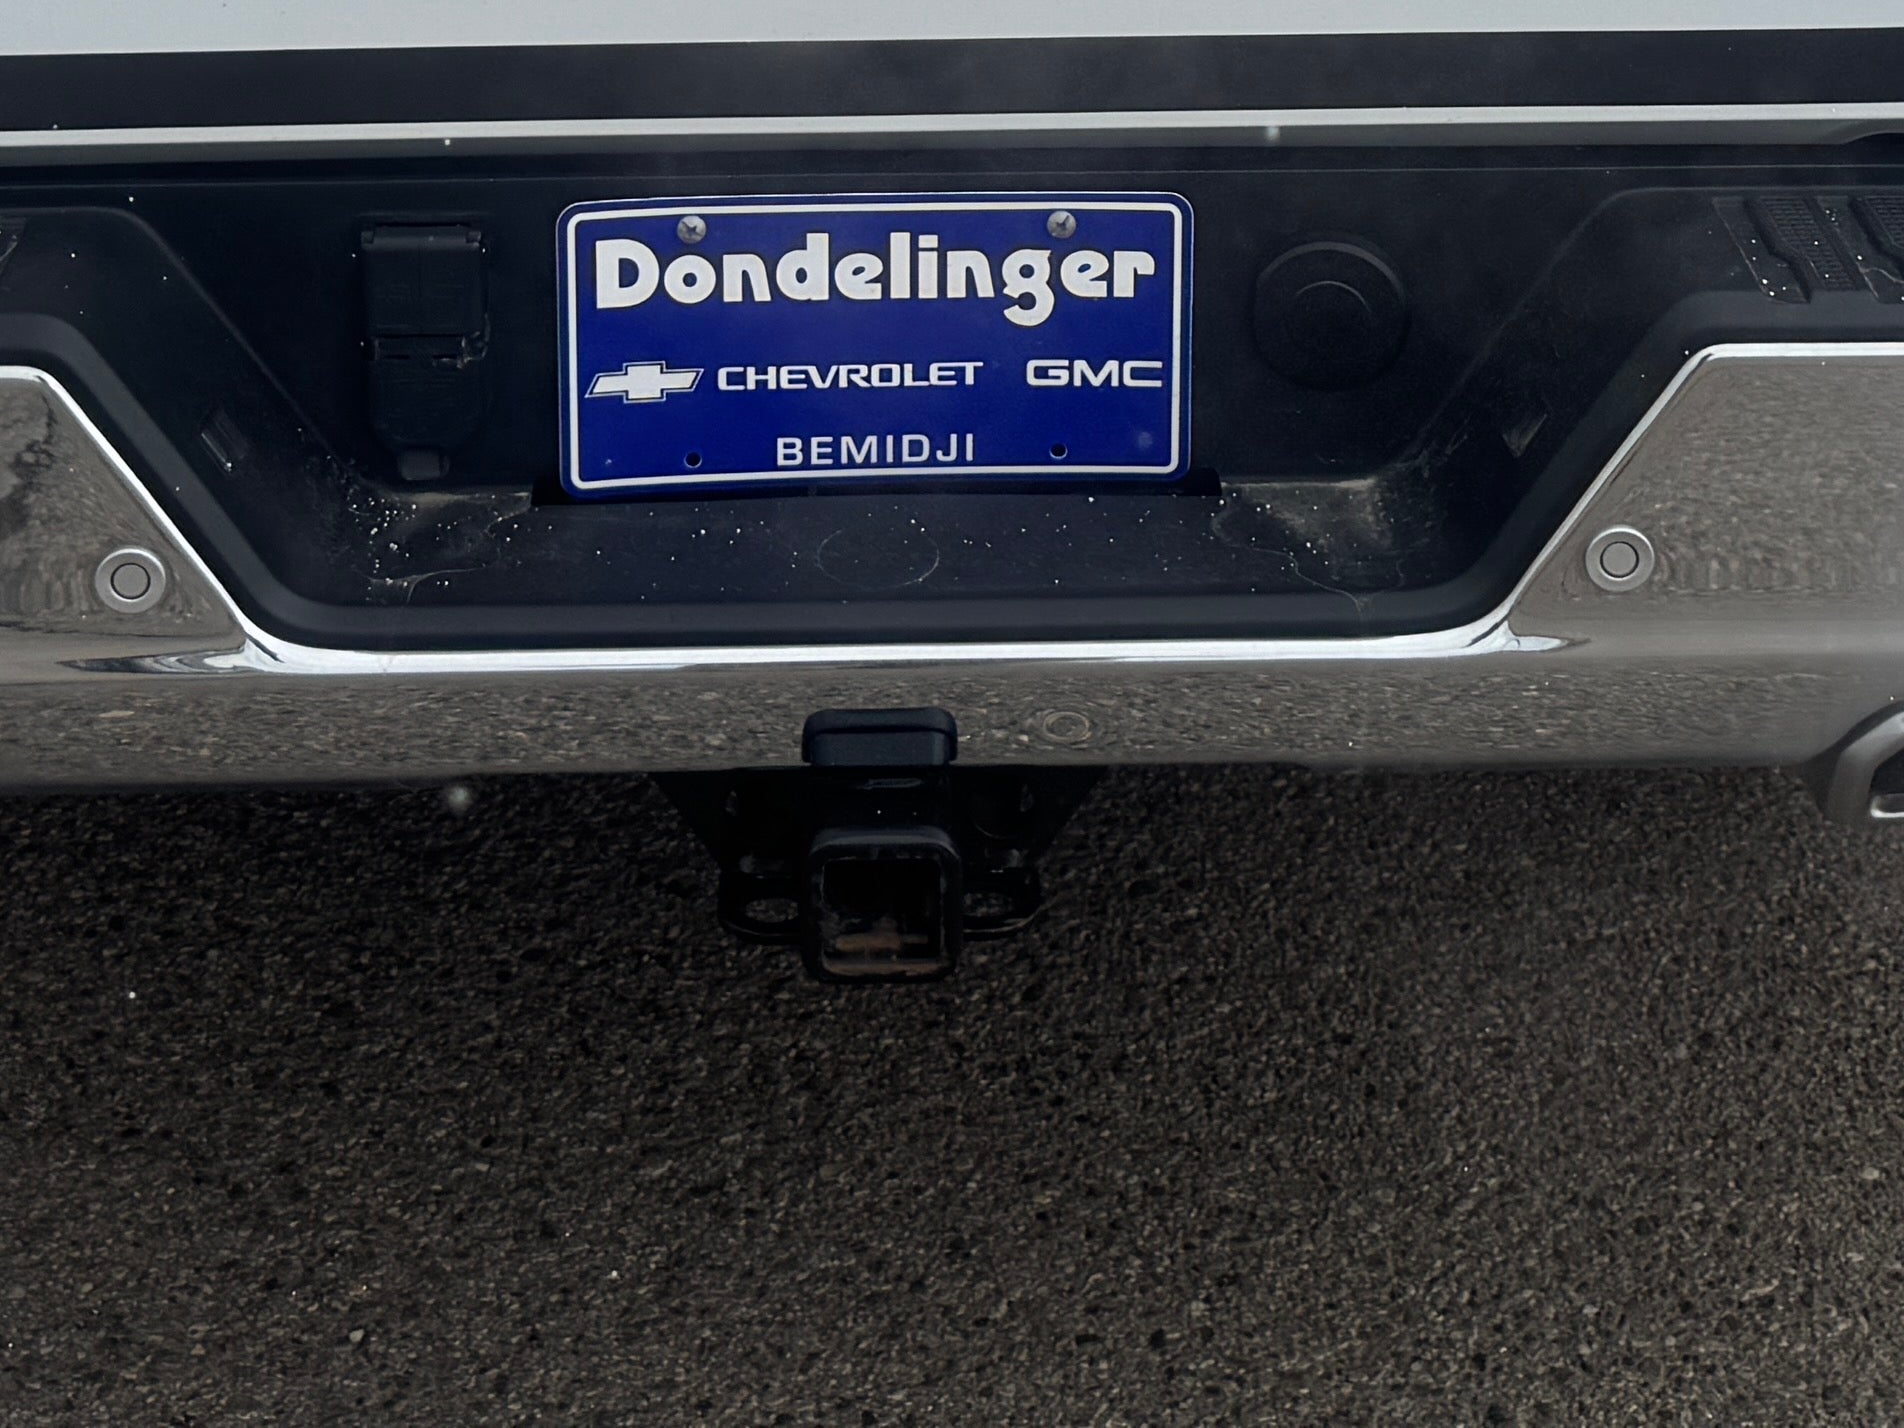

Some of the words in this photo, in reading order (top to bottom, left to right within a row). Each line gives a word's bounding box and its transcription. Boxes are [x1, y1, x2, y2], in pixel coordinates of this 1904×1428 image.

[595, 231, 1156, 326] Dondelinger
[717, 361, 984, 391] CHEVROLET
[1025, 359, 1163, 388] GMC
[776, 433, 975, 467] BEMIDJI
